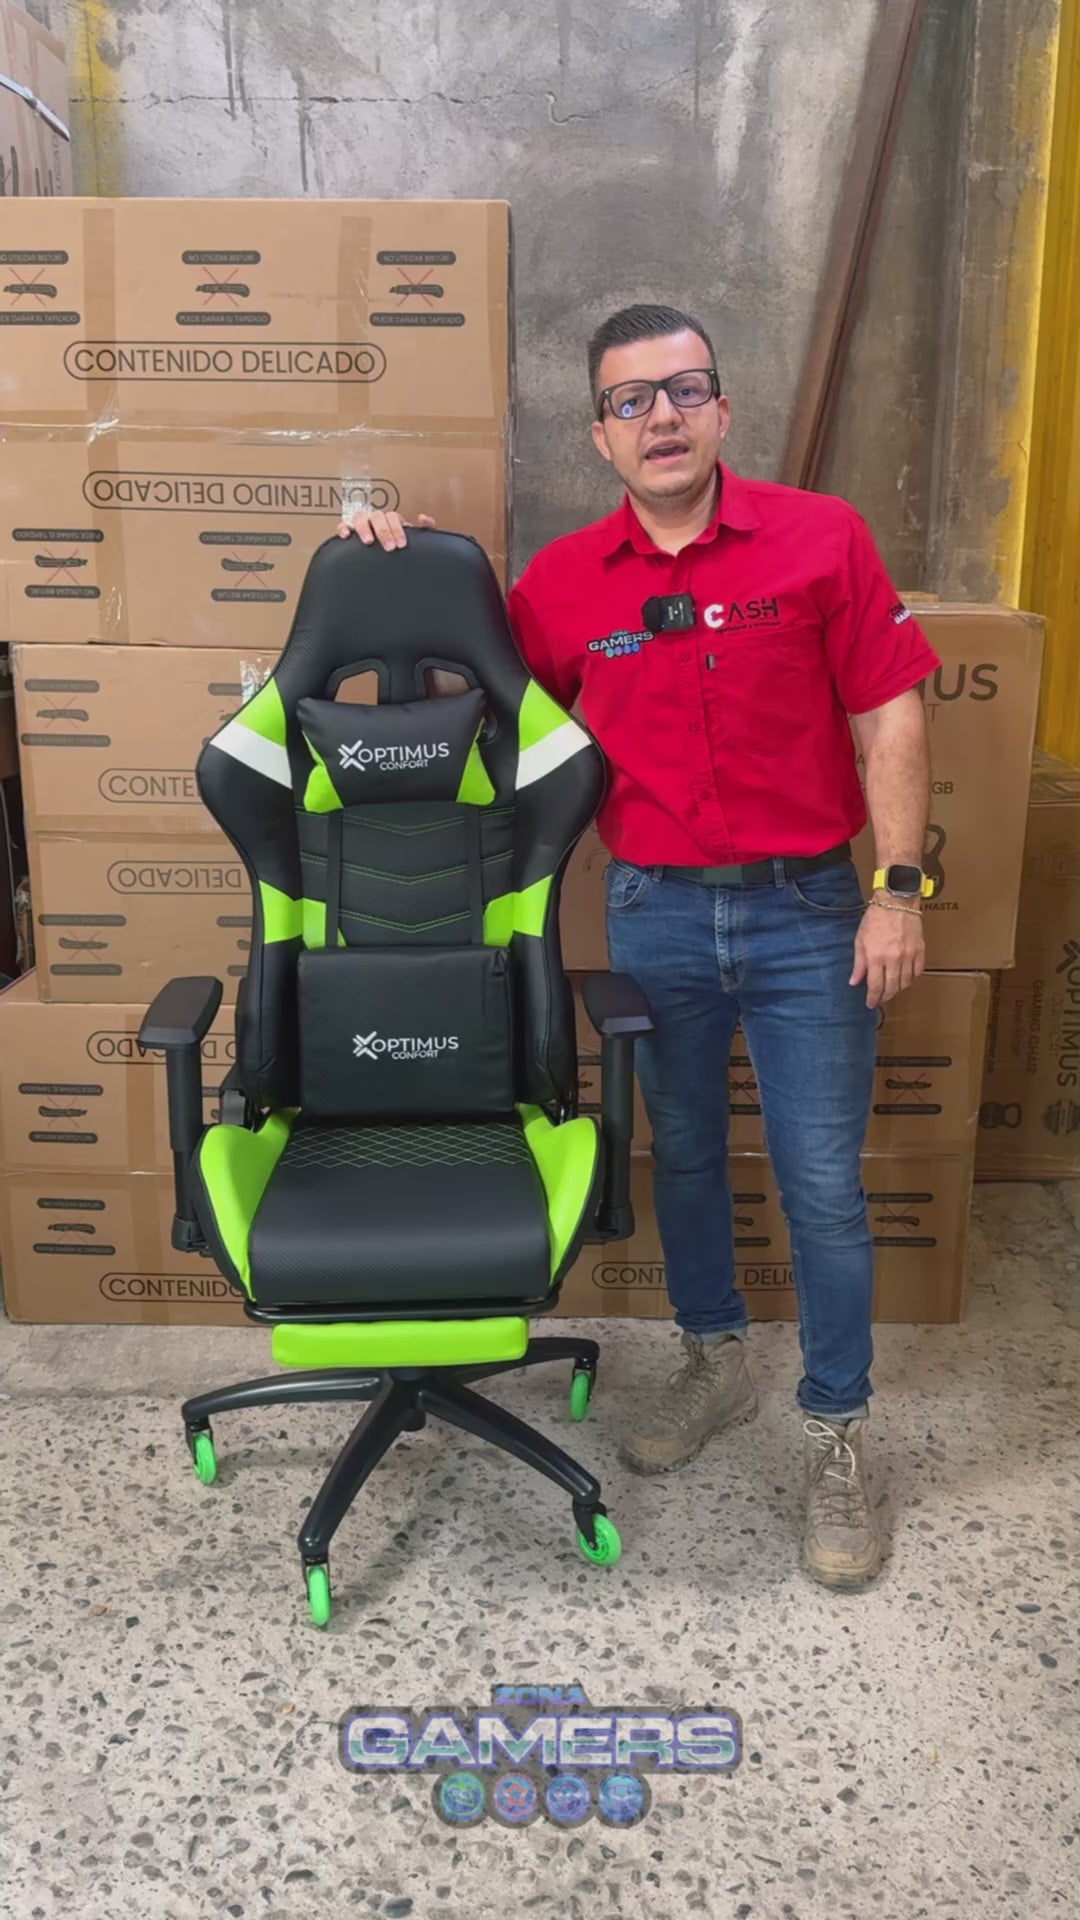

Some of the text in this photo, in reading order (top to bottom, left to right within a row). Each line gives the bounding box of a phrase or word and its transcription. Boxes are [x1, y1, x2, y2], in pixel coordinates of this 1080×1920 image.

[75, 349, 375, 374] CONTENIDO DELICADO
[93, 479, 390, 511] CONTENIDO DELICADO
[703, 597, 780, 628] CASH
[588, 631, 654, 651] GAMERS
[357, 742, 450, 764] OPTIMUS
[379, 759, 428, 771] CONFORT
[108, 775, 200, 797] CONTE
[118, 868, 242, 888] DELICADO
[371, 1036, 459, 1053] OPTIMUS
[391, 1049, 439, 1060] CONFORT
[743, 1268, 796, 1286] DELI
